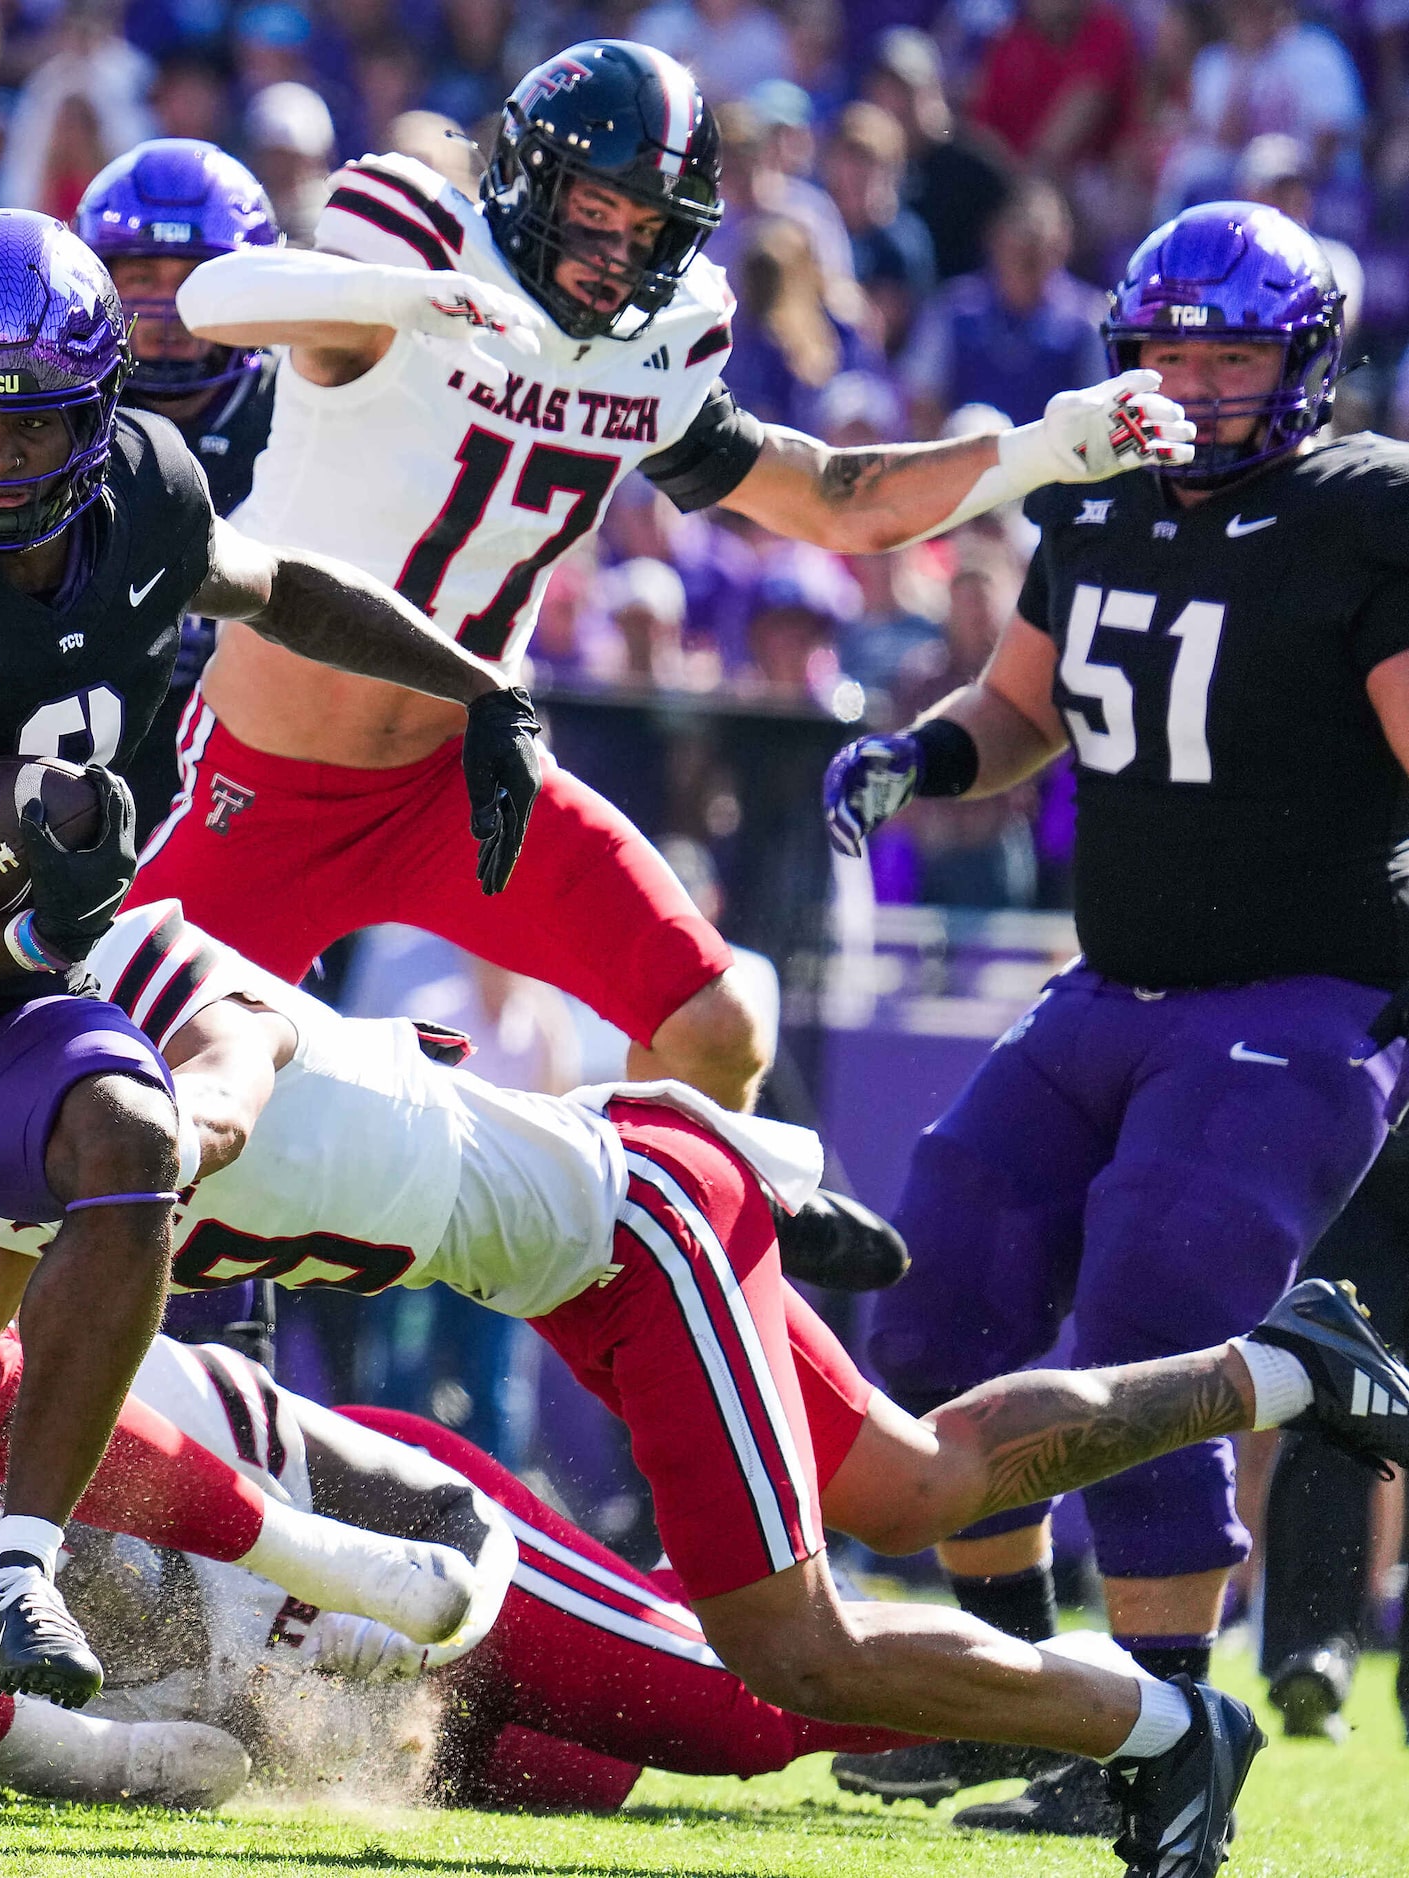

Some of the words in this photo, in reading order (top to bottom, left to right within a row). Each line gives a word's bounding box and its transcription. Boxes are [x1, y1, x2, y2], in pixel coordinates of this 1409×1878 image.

[1169, 304, 1209, 327] TCU
[578, 388, 661, 443] TECH
[393, 422, 623, 662] 17
[58, 631, 85, 655] TCU
[1057, 584, 1226, 784] 51
